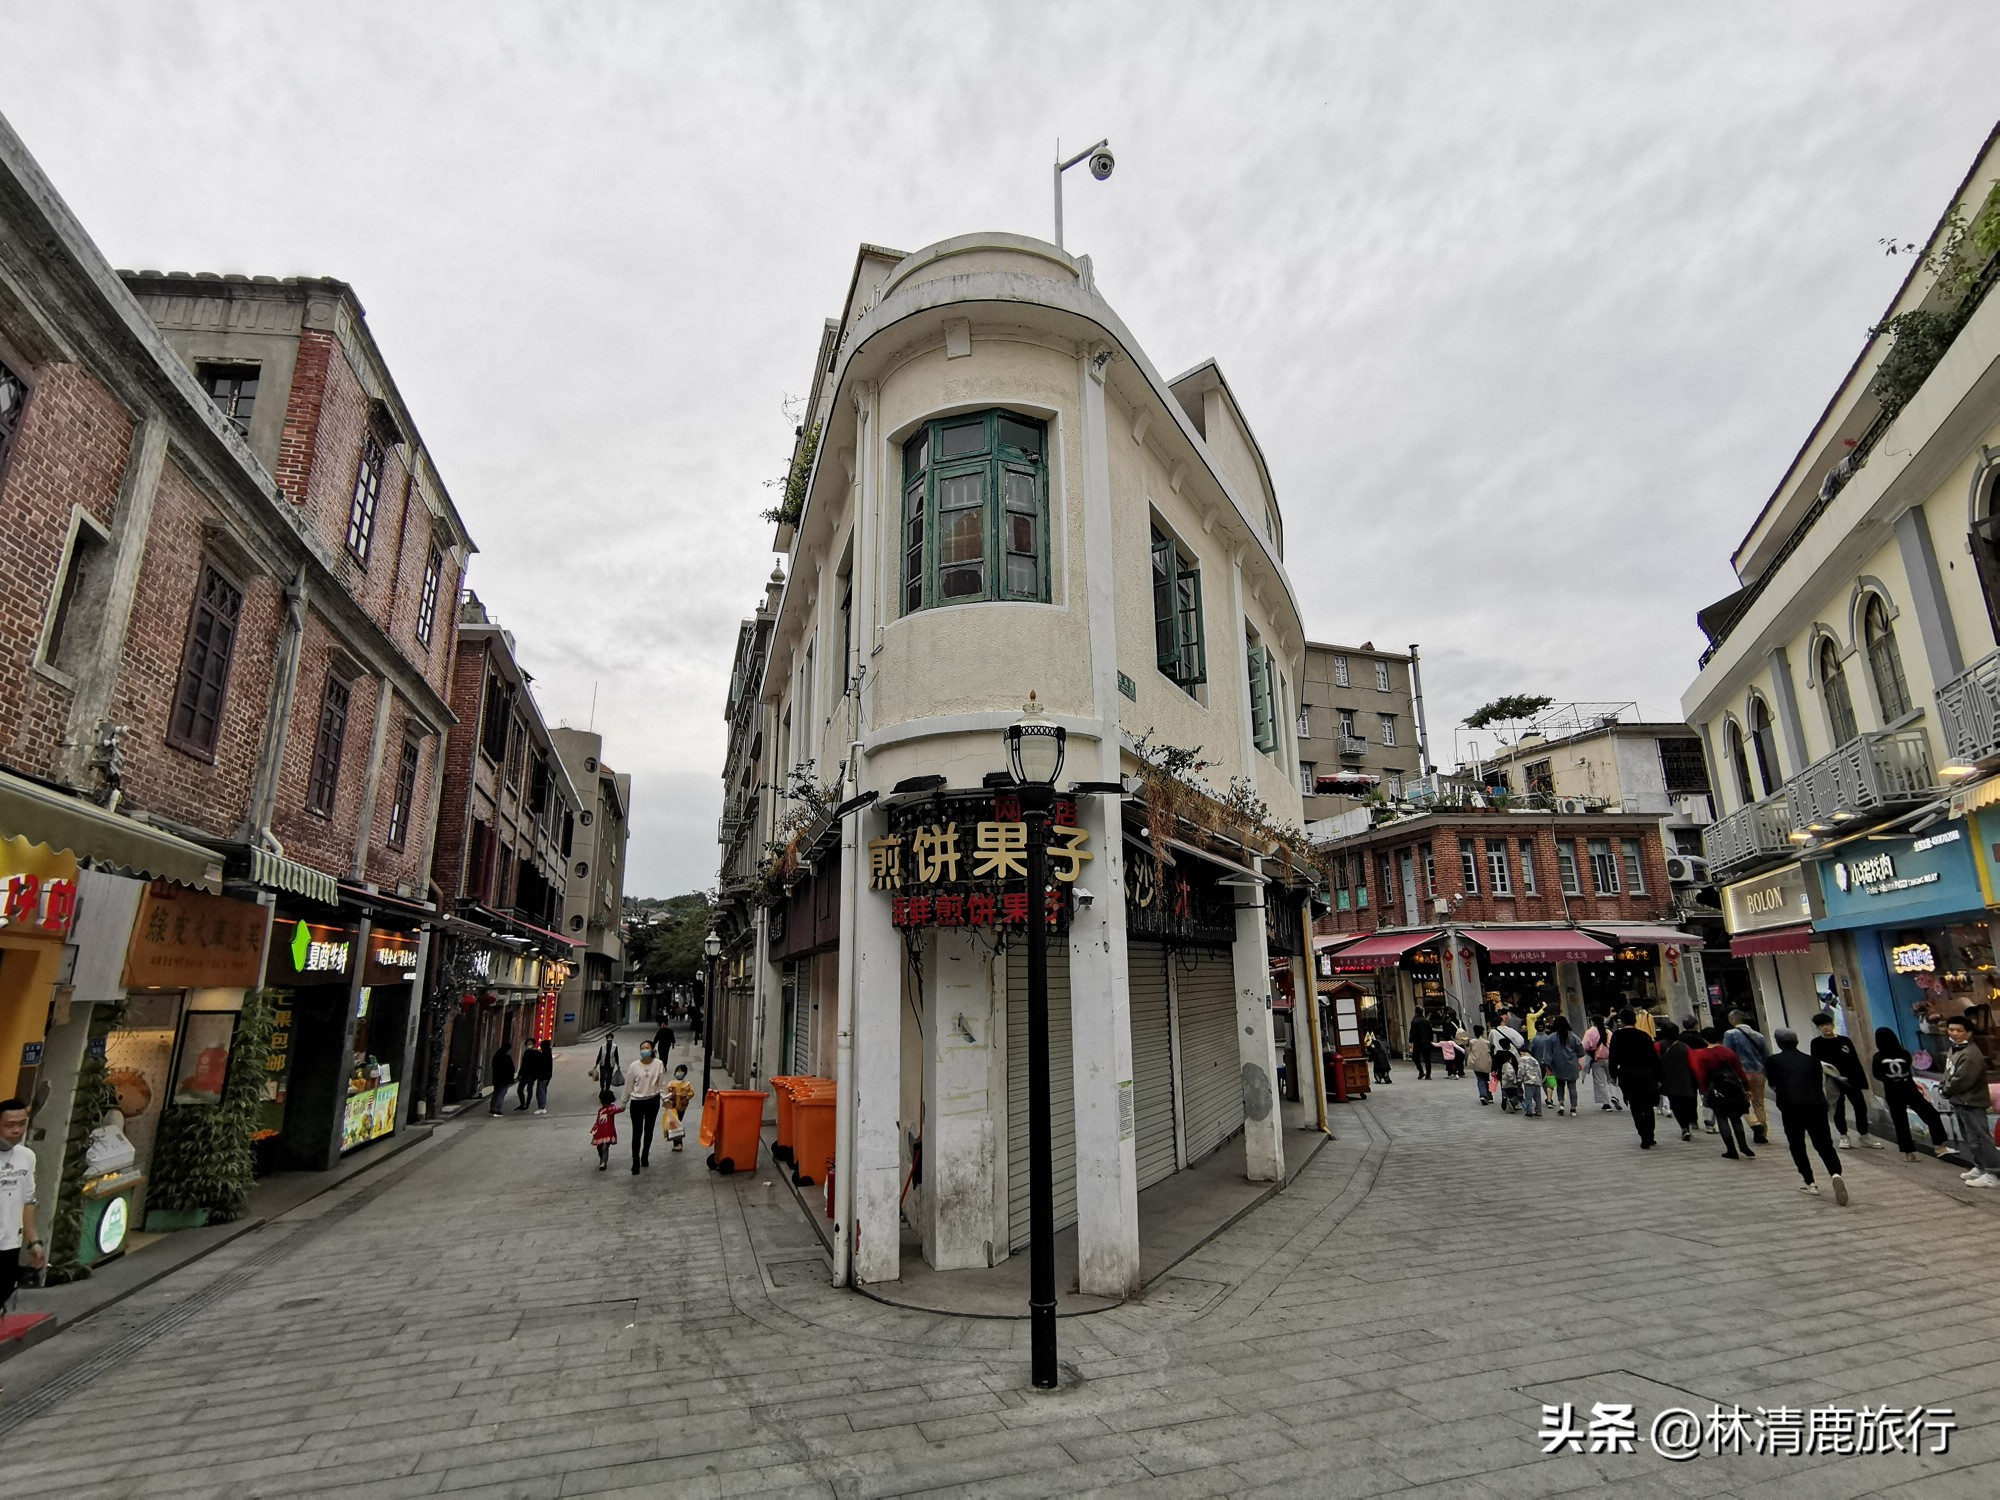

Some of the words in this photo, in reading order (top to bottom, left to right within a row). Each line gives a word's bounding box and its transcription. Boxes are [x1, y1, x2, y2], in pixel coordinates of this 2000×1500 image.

[995, 796, 1078, 827] 网店
[868, 821, 1094, 890] 煎饼果子
[1851, 852, 1893, 886] 小猪找肉
[1746, 886, 1783, 914] BOLON
[307, 940, 349, 974] 夏商生鲜
